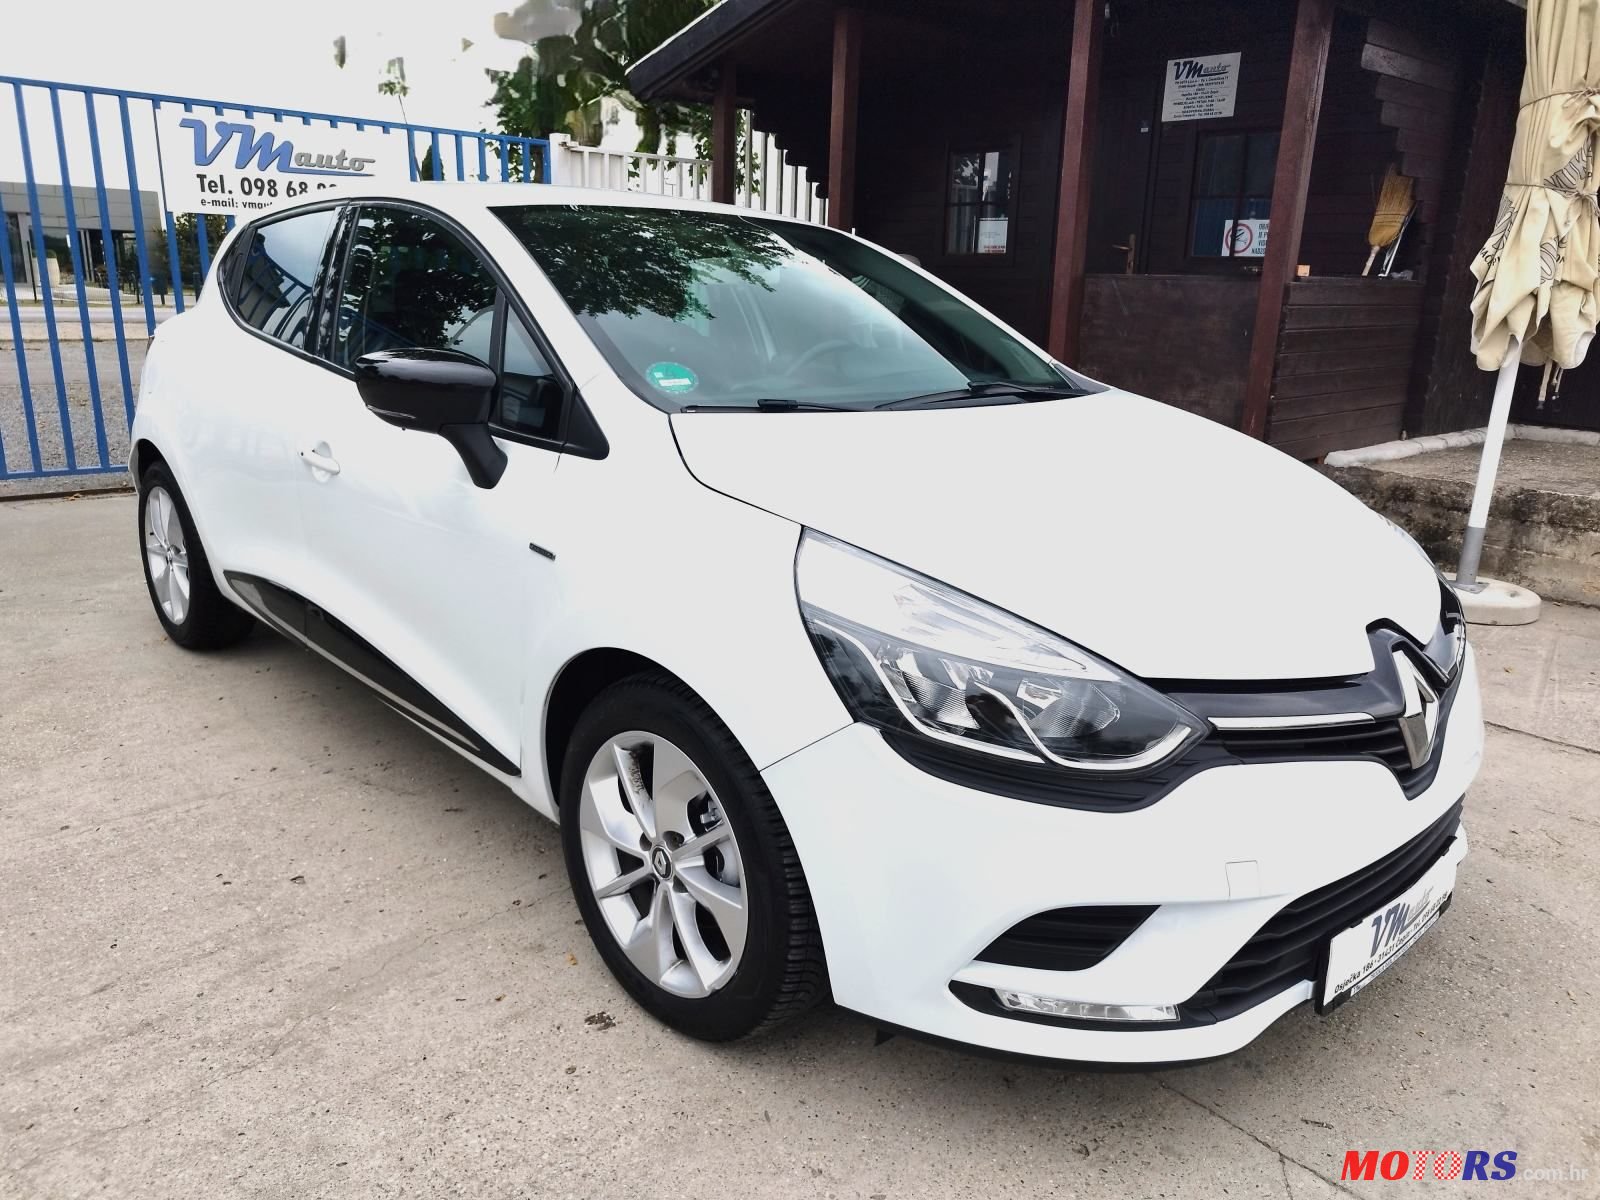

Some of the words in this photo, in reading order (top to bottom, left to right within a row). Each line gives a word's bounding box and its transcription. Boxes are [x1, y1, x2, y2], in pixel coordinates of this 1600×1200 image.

[1174, 60, 1204, 80] VM
[179, 118, 294, 172] VM
[294, 149, 376, 171] auto
[196, 173, 233, 195] Tel.
[240, 177, 278, 198] 098
[286, 181, 308, 198] 68
[200, 198, 238, 209] e-mail:
[242, 201, 273, 210] vma
[1363, 961, 1374, 974] 186
